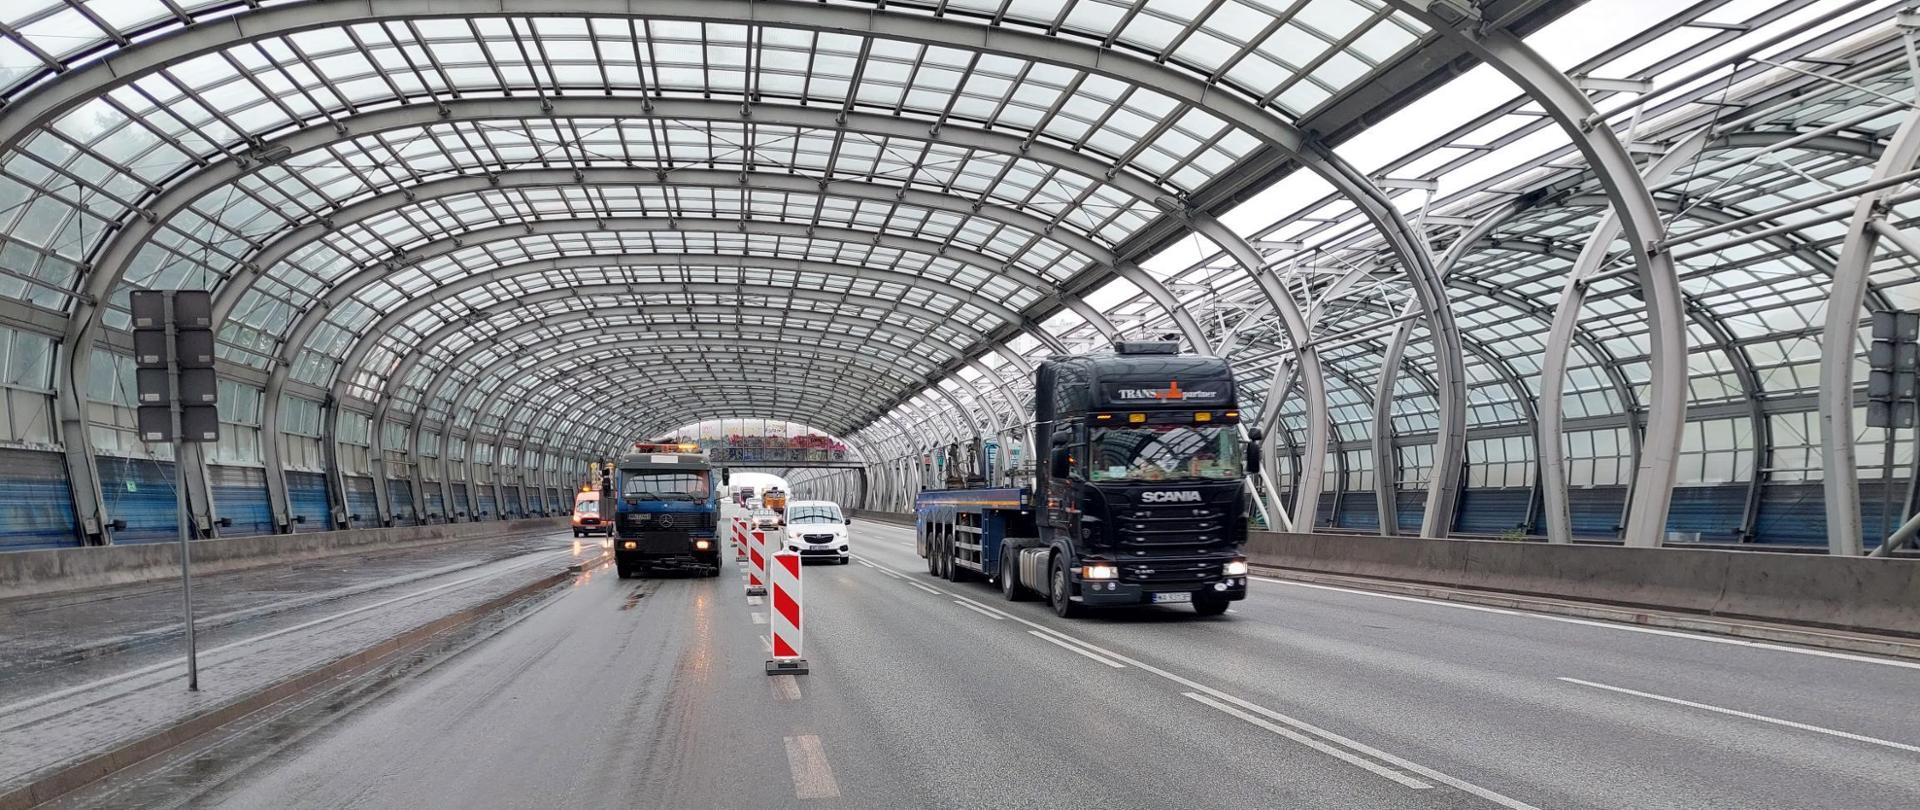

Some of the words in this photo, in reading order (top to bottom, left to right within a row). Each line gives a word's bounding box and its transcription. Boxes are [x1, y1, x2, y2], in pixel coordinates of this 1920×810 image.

[1118, 389, 1156, 399] TRANS
[1182, 391, 1217, 401] partner
[1141, 490, 1203, 503] SCANIA
